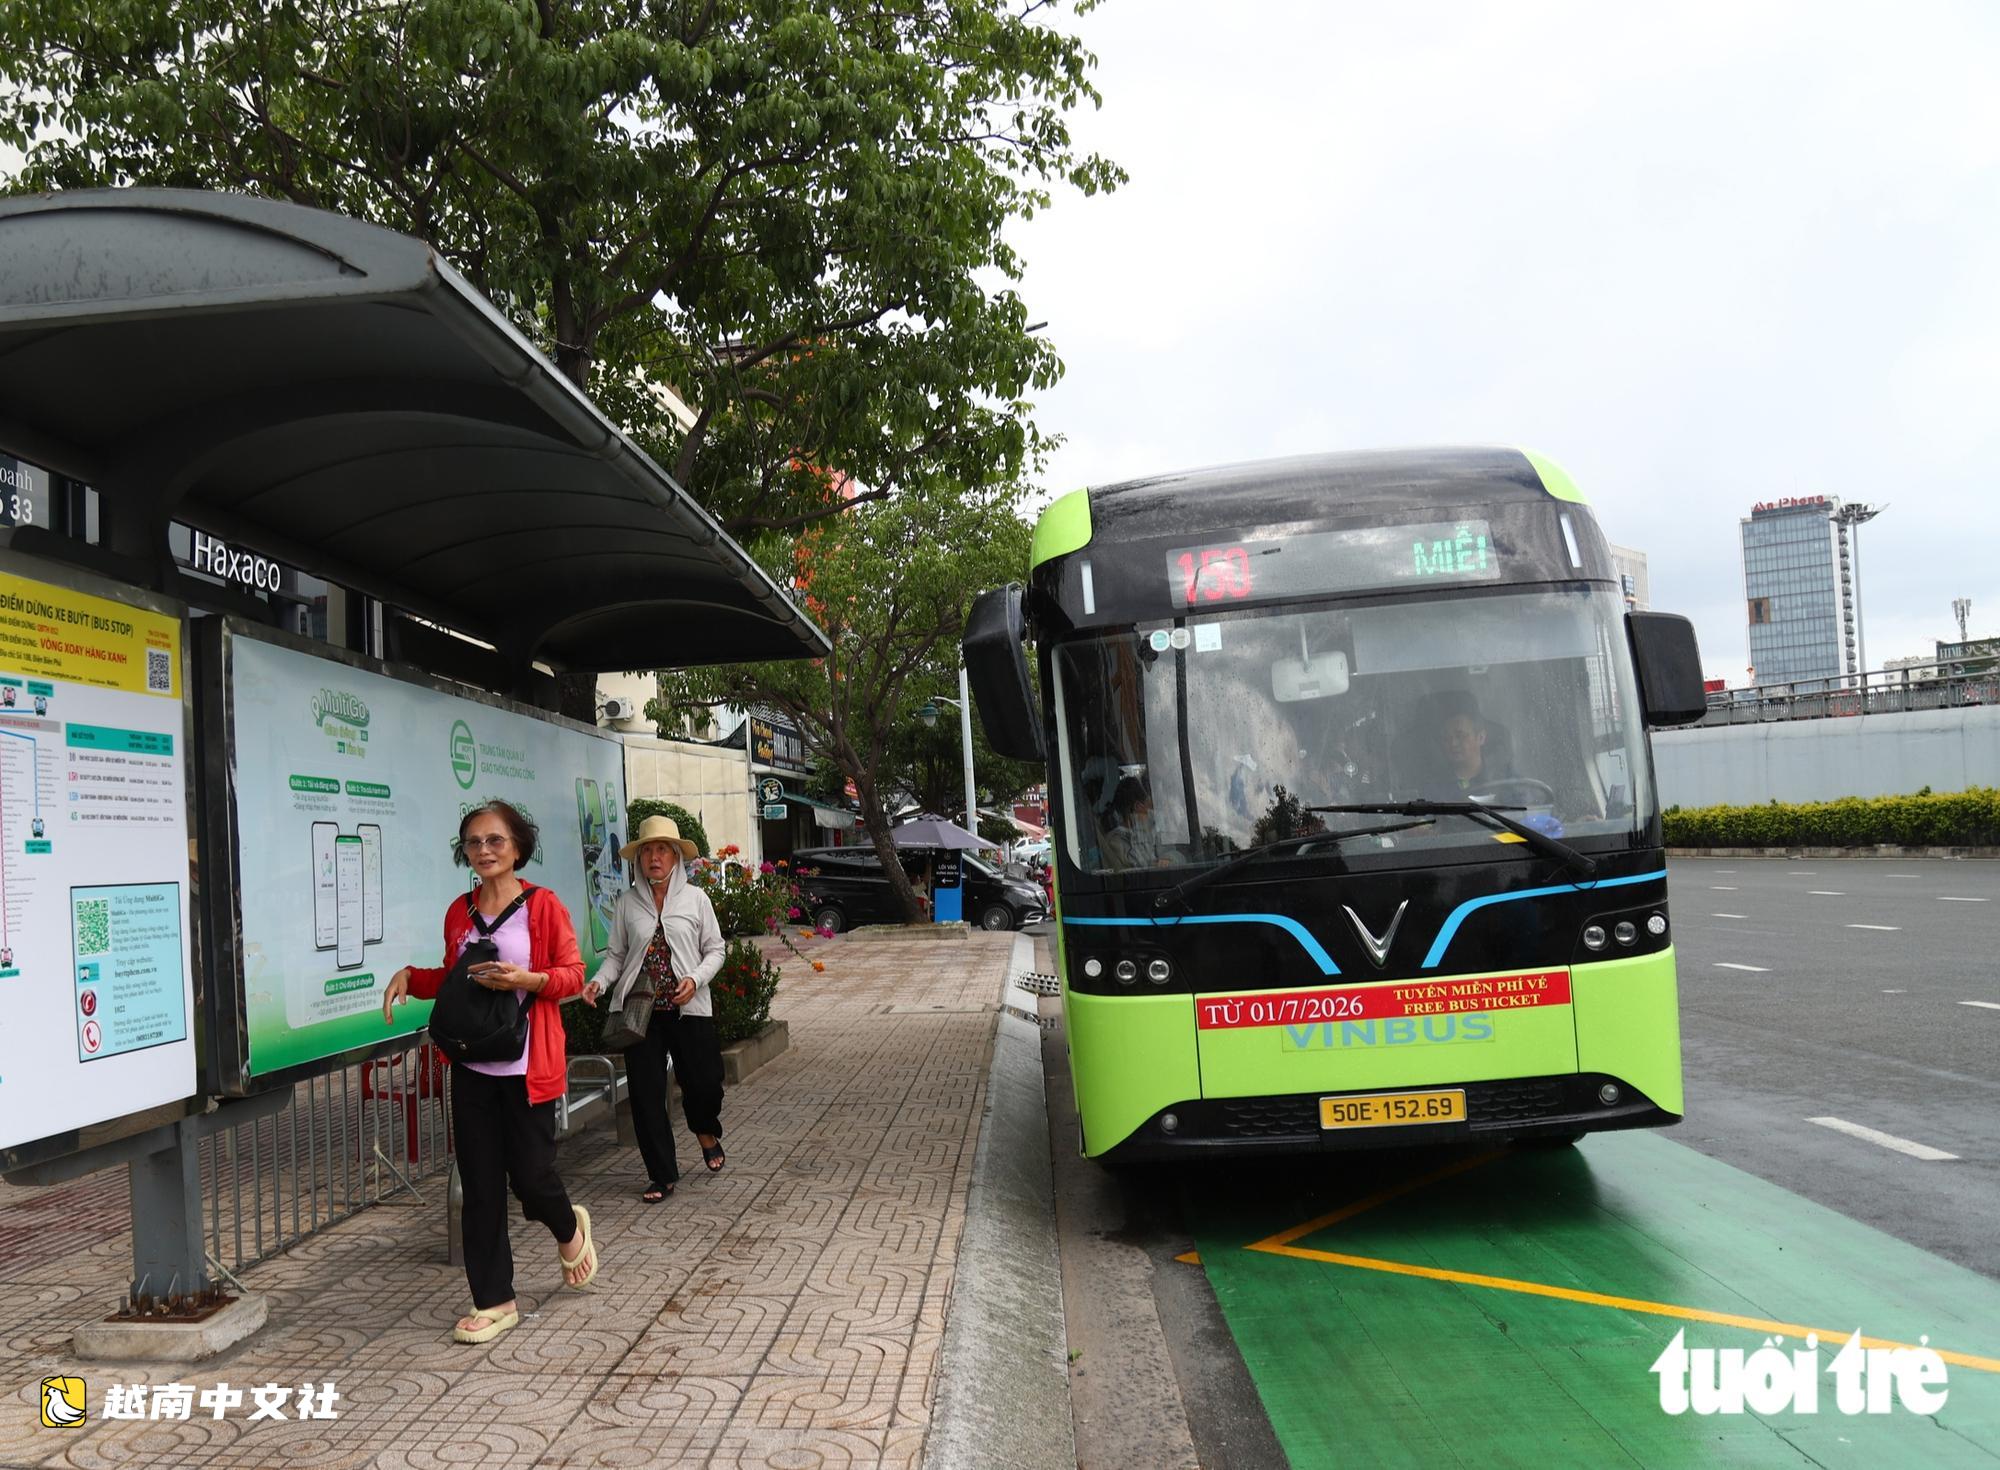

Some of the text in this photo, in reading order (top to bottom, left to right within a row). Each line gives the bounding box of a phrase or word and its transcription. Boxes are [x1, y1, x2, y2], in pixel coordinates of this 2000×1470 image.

[10, 494, 33, 524] 33
[194, 530, 281, 593] Haxaco
[1177, 546, 1253, 604] 150
[55, 607, 66, 622] XE
[67, 609, 89, 627] BUÝT
[91, 615, 109, 631] (BUS
[111, 620, 134, 639] STOP)
[40, 636, 63, 652] VÒNG
[64, 642, 83, 656] XOAY
[107, 651, 127, 664] XANH
[320, 688, 368, 720] MultiGo
[1497, 977, 1524, 993] PHÍ
[1527, 975, 1548, 990] VÉ
[1205, 995, 1364, 1025] TỪ 01/7/2026
[1404, 993, 1541, 1015] FREE BUS TICKET
[1285, 1013, 1493, 1049] VINBUS
[1333, 1097, 1453, 1123] 50E-152.69
